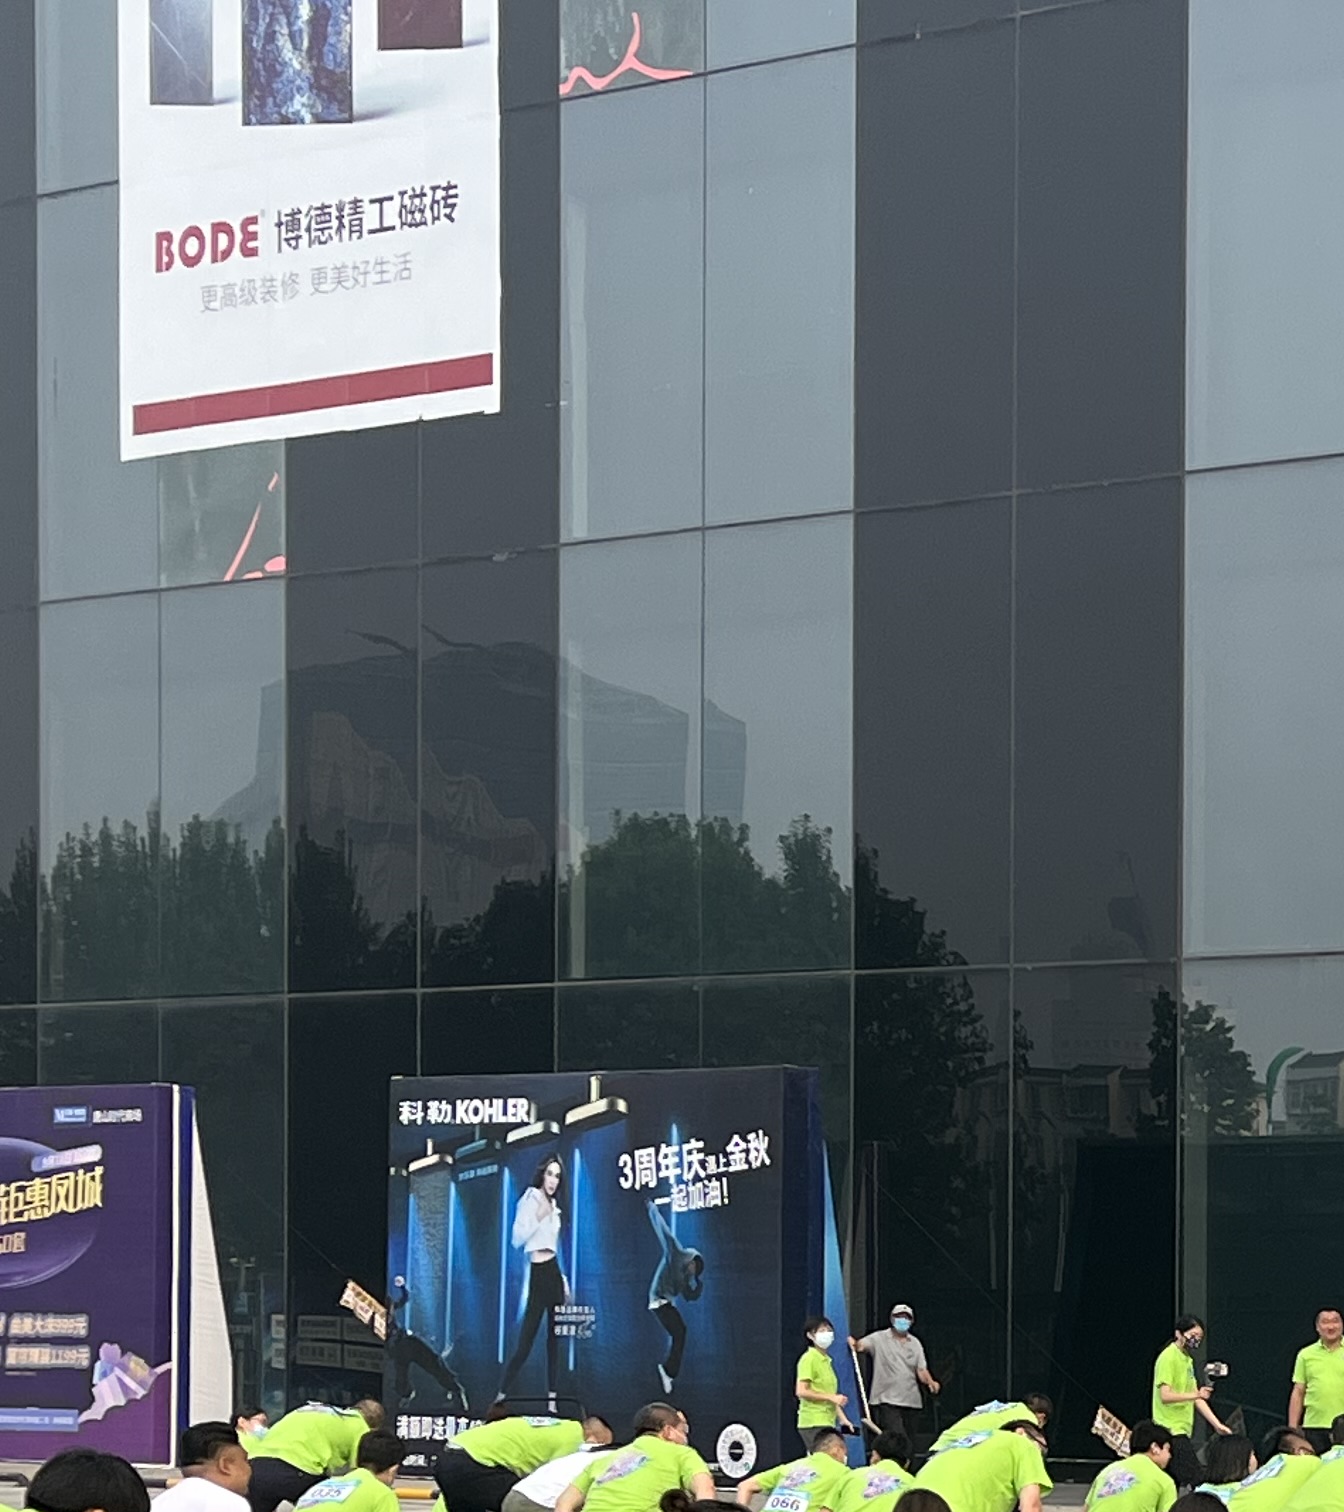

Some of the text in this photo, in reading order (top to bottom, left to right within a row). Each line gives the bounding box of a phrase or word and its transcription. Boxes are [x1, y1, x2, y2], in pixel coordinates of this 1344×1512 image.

[155, 215, 259, 273] BODE
[275, 180, 459, 254] 博德精工磁砖
[200, 251, 413, 314] 更高级装修 更美好生活
[399, 1097, 530, 1125] 科勒 KOHLER
